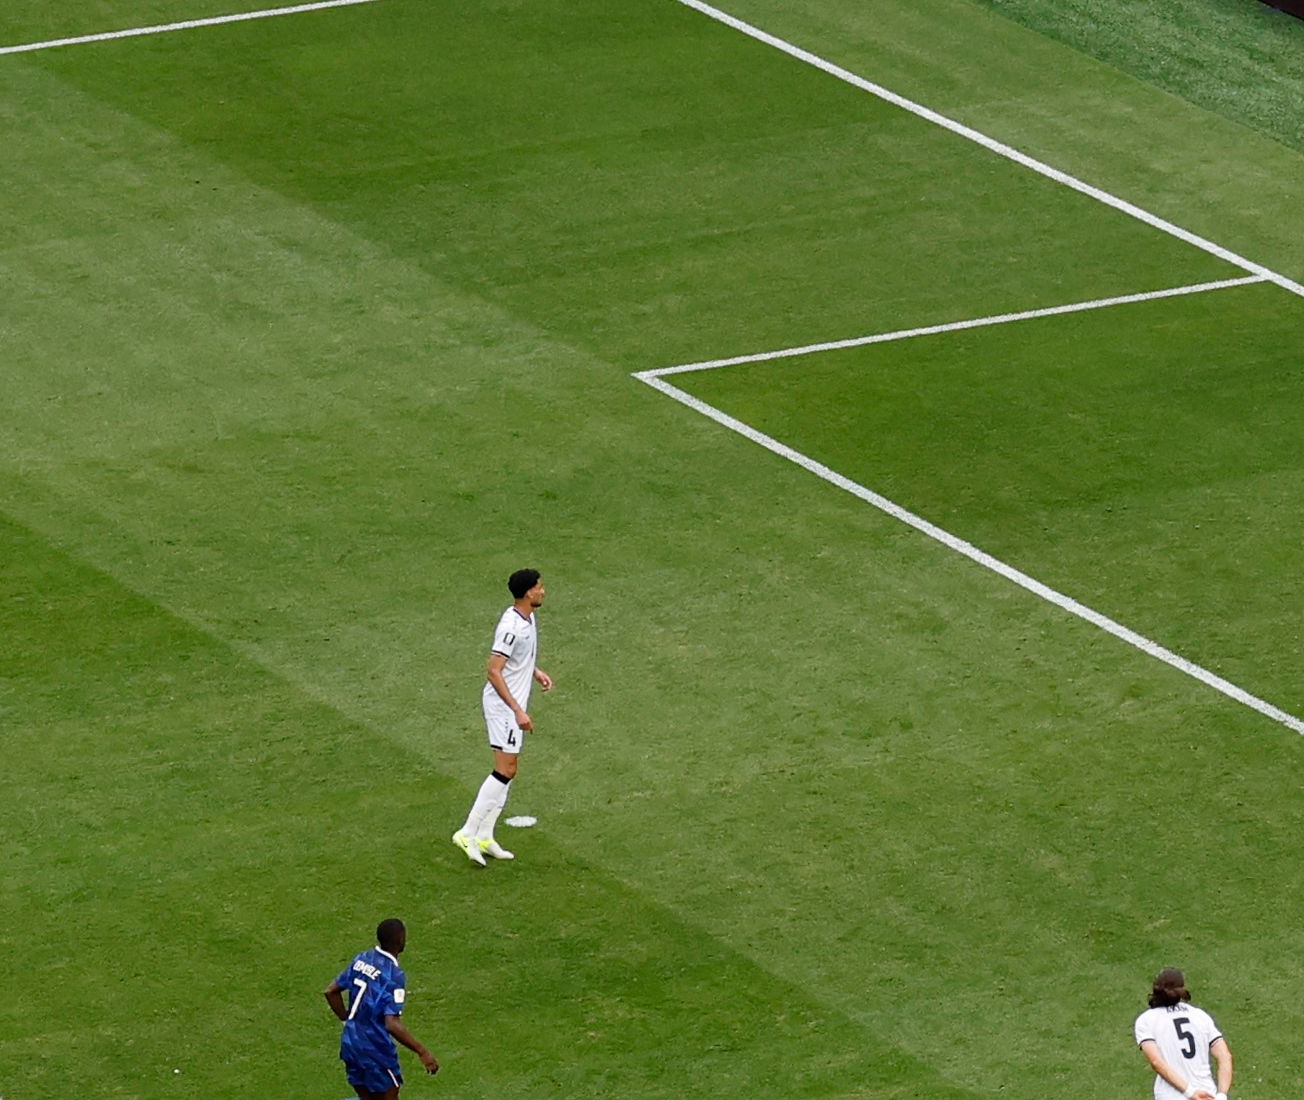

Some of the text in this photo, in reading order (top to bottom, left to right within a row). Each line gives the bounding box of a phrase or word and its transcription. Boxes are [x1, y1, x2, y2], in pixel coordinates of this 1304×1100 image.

[507, 729, 516, 747] 4
[348, 978, 367, 1020] 7
[1173, 1017, 1196, 1059] 5
